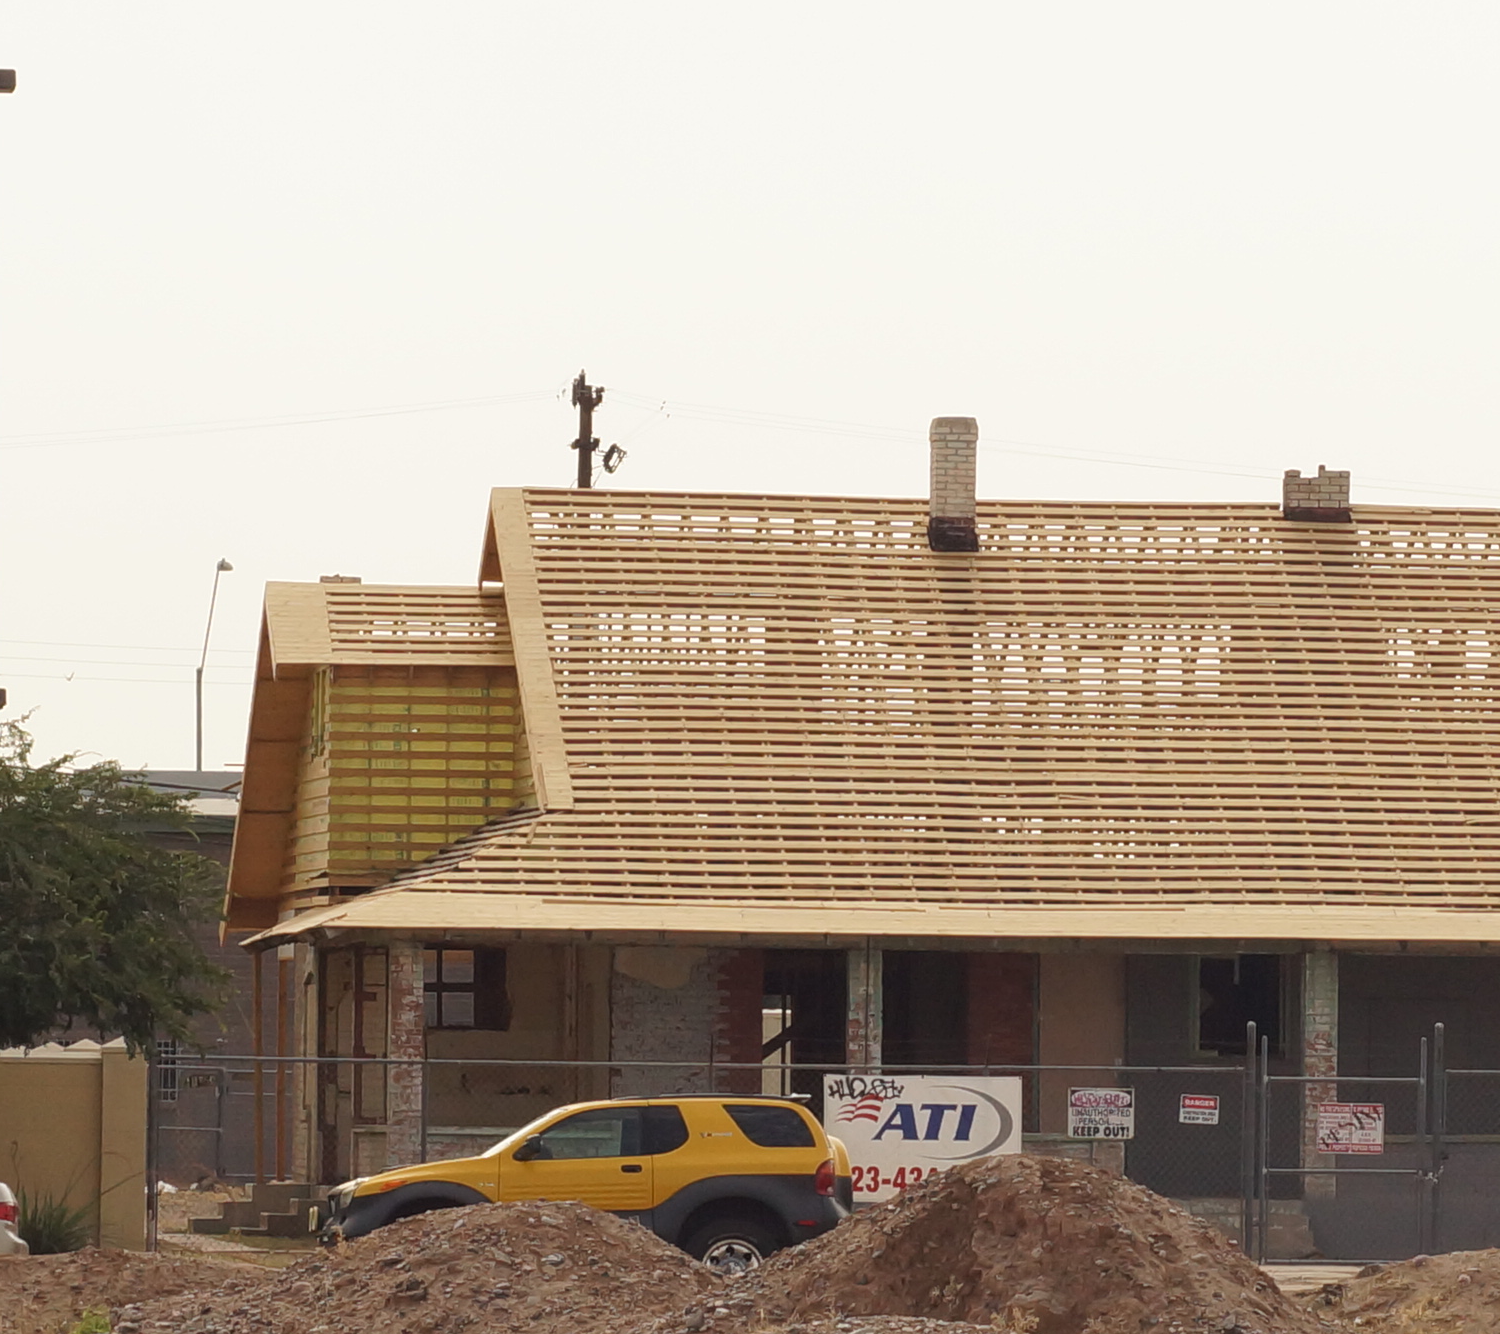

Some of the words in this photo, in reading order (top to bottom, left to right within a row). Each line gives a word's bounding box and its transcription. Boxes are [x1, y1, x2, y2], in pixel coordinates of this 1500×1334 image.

[871, 1103, 978, 1141] ATI
[1073, 1126, 1100, 1137] KEEP
[1103, 1126, 1130, 1137] OUT!
